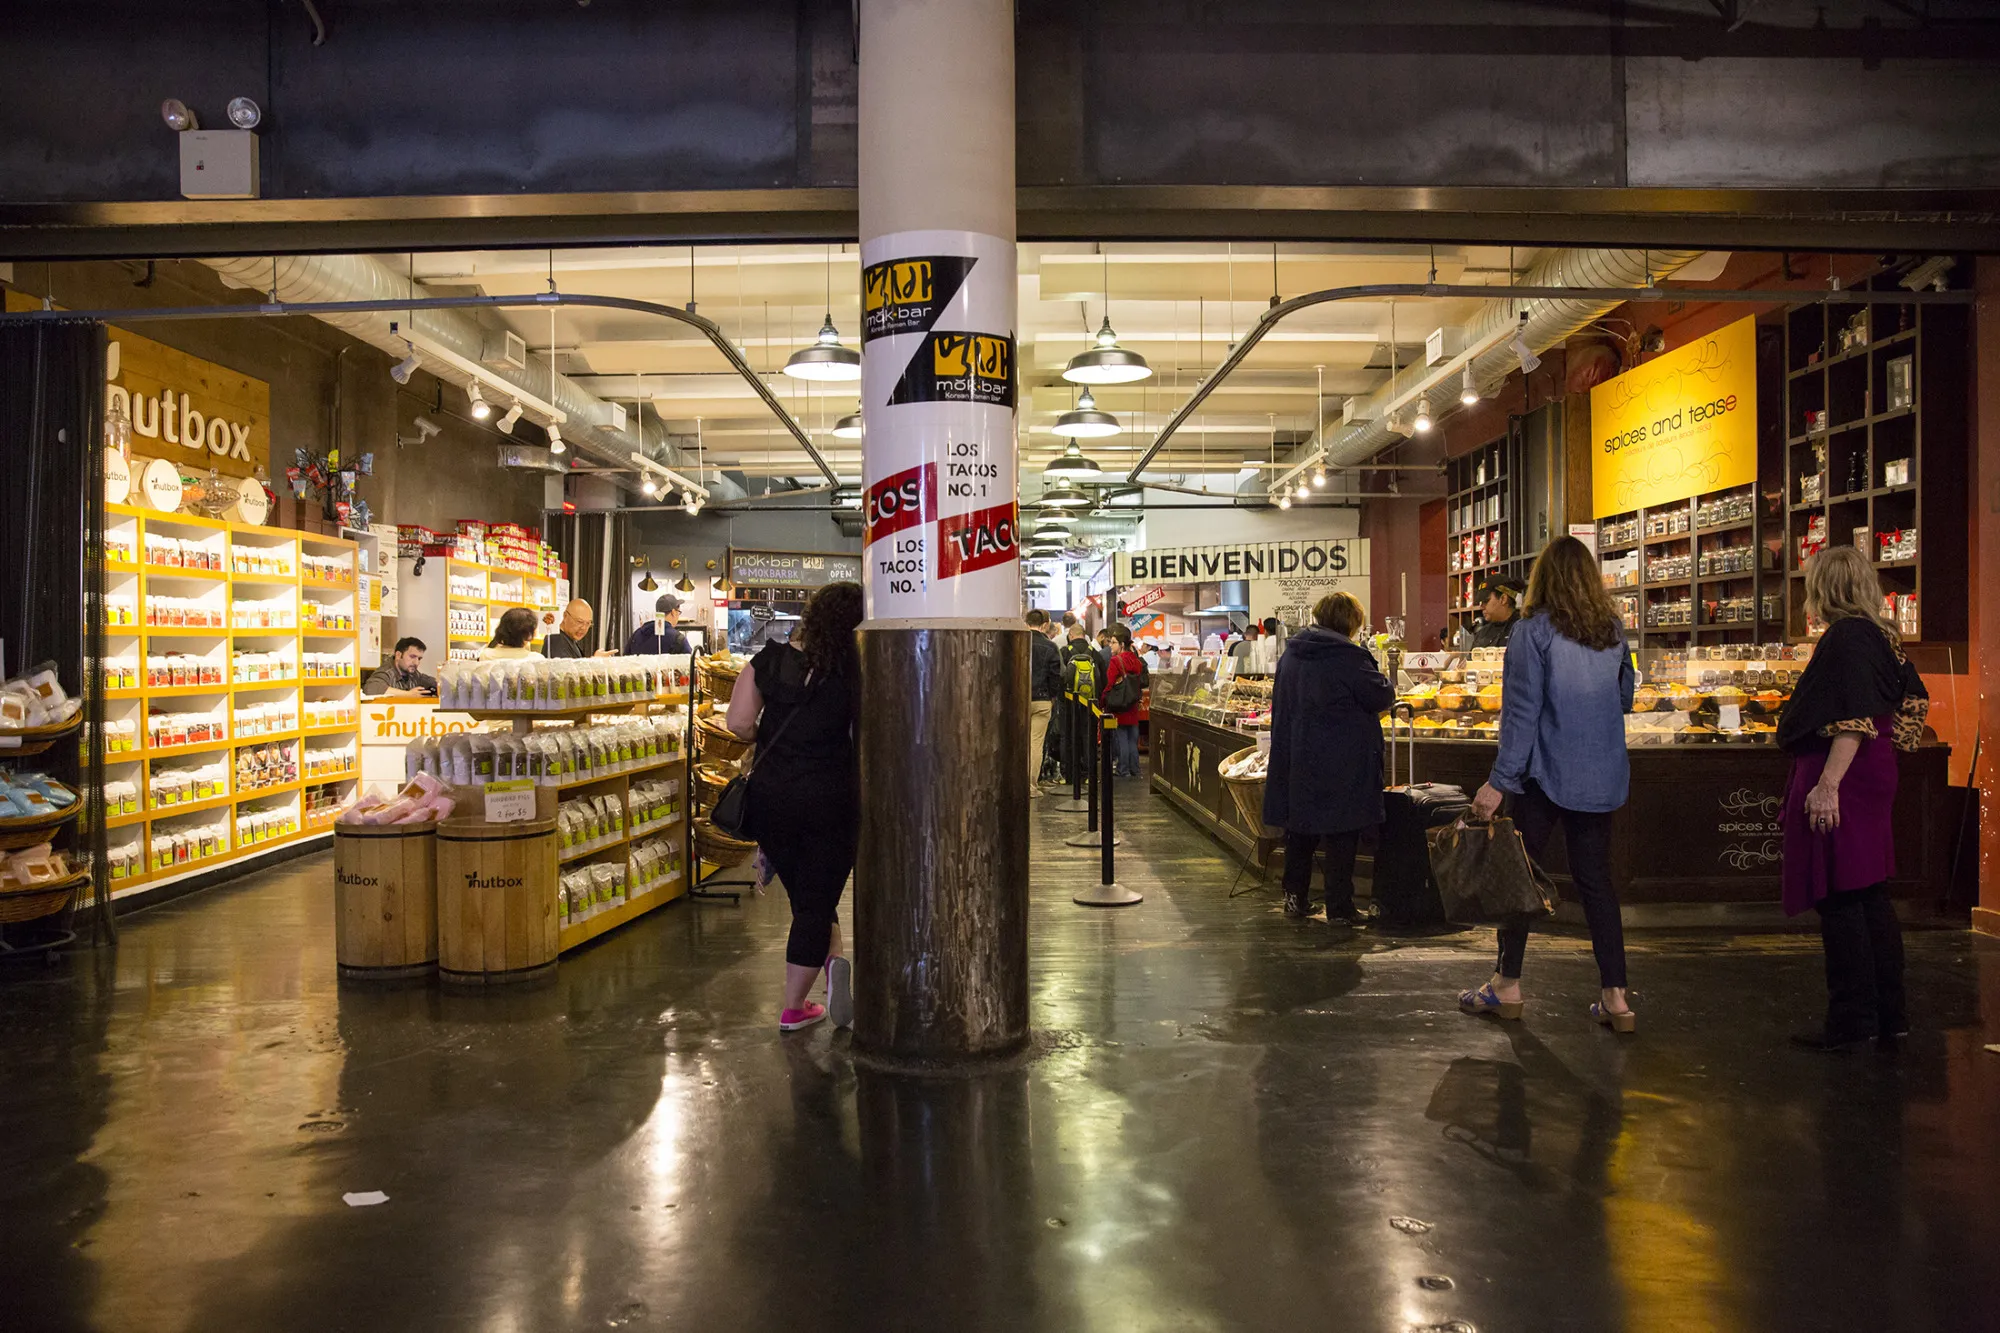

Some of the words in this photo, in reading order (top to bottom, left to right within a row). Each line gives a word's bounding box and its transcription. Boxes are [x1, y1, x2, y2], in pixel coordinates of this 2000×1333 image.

[907, 319, 920, 327] Bar
[1604, 426, 1647, 455] spices
[1651, 408, 1683, 437] and
[1688, 394, 1737, 425] tease
[947, 443, 978, 457] LOS
[106, 469, 128, 482] utbox
[946, 463, 997, 478] TACOS
[154, 482, 180, 493] nutbox
[948, 483, 977, 497] NO.
[981, 484, 986, 497] 1
[864, 478, 922, 528] COS
[897, 540, 927, 553] LOS
[833, 562, 847, 570] NOW
[880, 560, 927, 575] TACOS
[1131, 545, 1347, 579] BIENVENIDOS
[830, 569, 853, 579] OPEN
[890, 580, 916, 594] NO.
[1126, 598, 1146, 615] ORDER
[1718, 821, 1763, 833] spices
[338, 873, 379, 887] nutbox
[474, 875, 523, 889] nutbox
